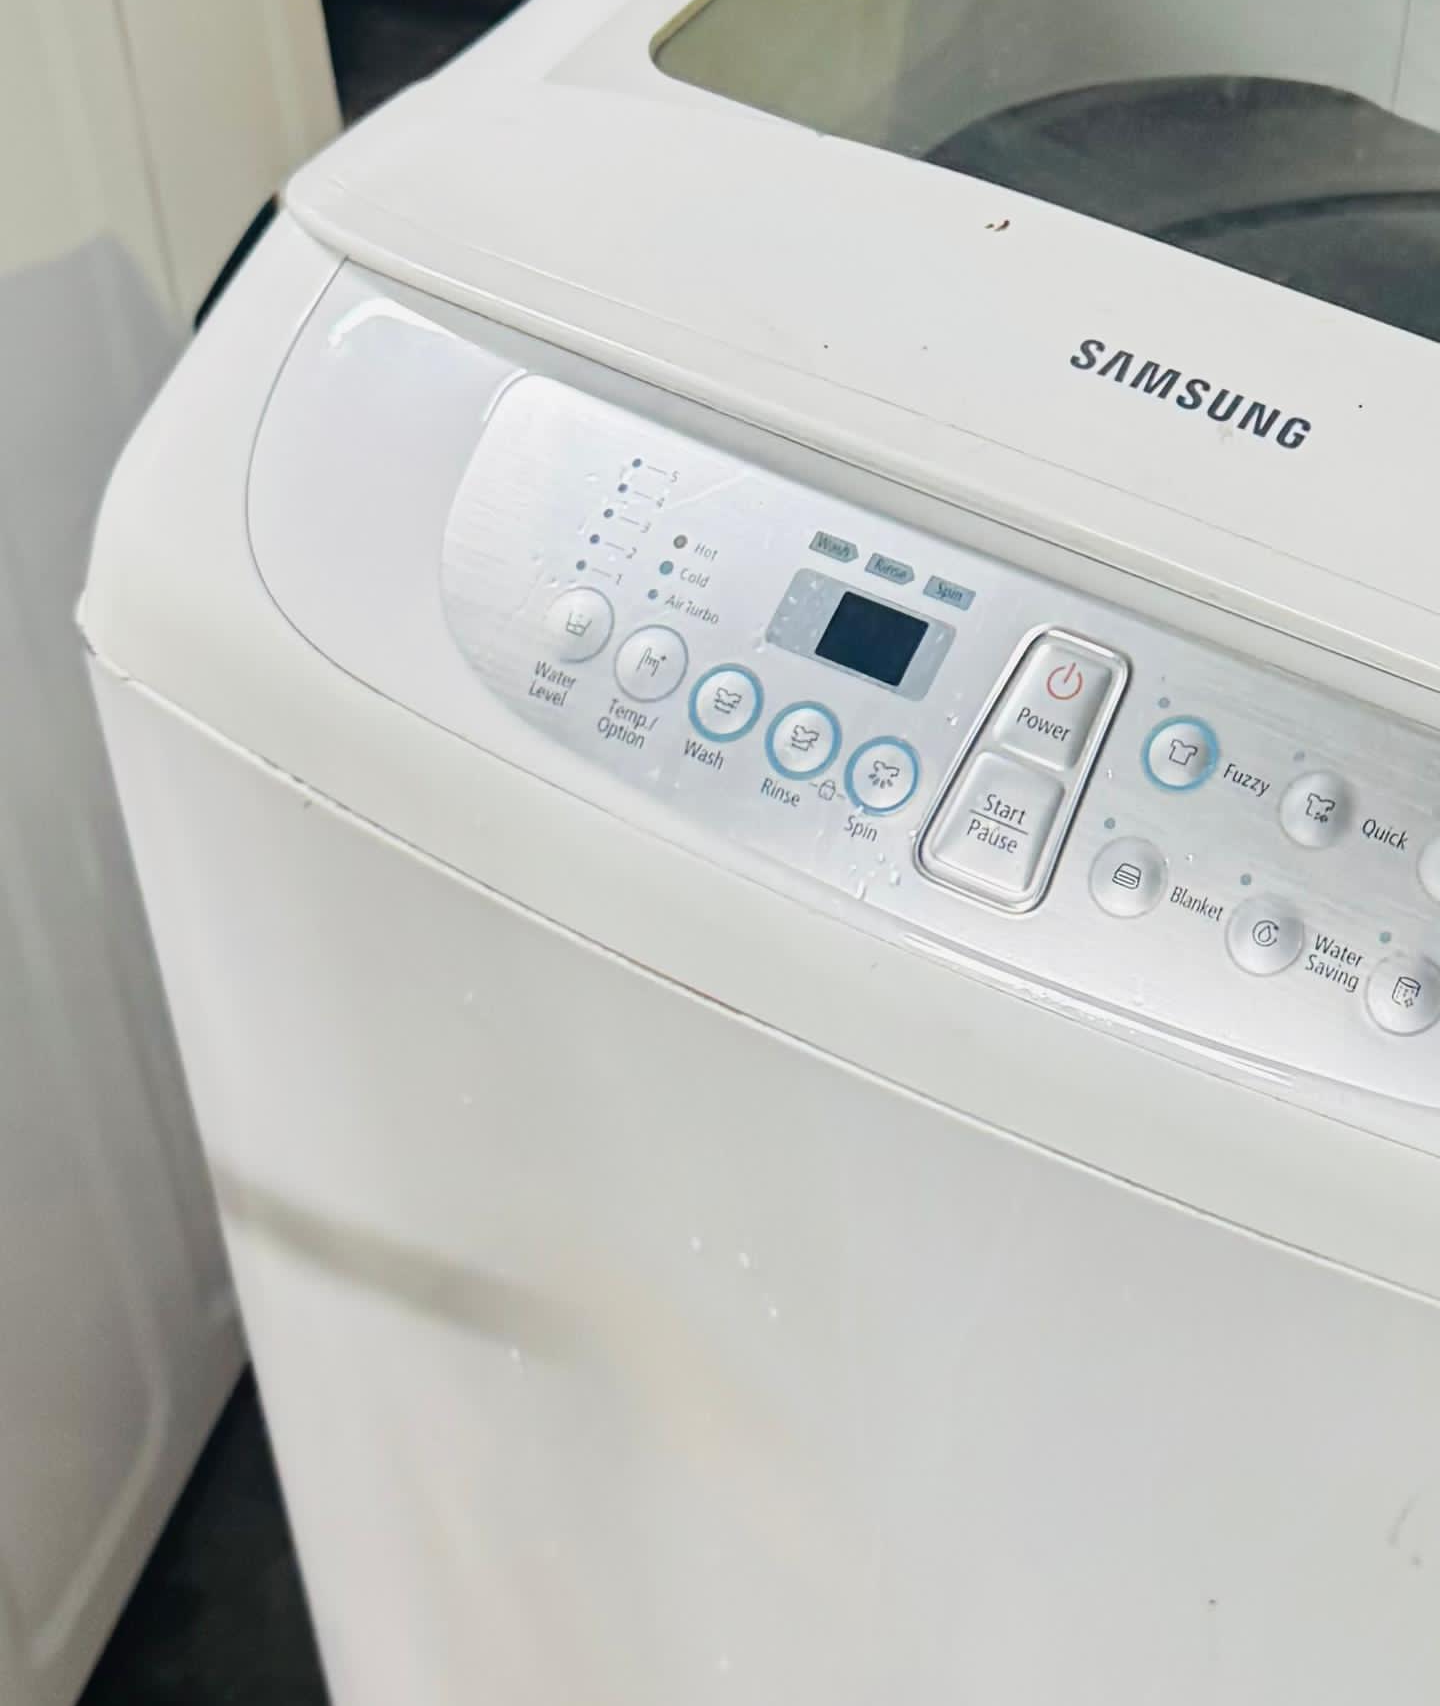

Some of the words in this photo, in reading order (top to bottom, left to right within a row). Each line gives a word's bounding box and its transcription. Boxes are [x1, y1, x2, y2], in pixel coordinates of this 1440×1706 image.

[1069, 339, 1312, 449] SAMSUNG
[671, 470, 680, 483] 5
[626, 547, 637, 559] 2
[694, 543, 718, 561] Hot
[817, 536, 849, 558] Wash
[615, 573, 623, 585] 1
[680, 568, 710, 588] Cold
[874, 558, 907, 578] Rinse
[937, 581, 963, 601] Spin
[664, 594, 685, 609] Air
[686, 600, 720, 625] Turbo
[534, 660, 577, 690] Water
[528, 680, 568, 707] Level
[607, 698, 660, 731] Temp./
[1016, 706, 1071, 742] Power
[596, 717, 646, 750] Option
[683, 739, 725, 771] Wash
[760, 777, 801, 808] Rinse
[1223, 763, 1270, 798] Fuzzy
[983, 793, 1027, 826] Start
[843, 815, 879, 843] Spin
[966, 818, 1018, 854] Pause
[1361, 818, 1409, 850] Quick
[1170, 886, 1224, 923] Blanket
[1314, 933, 1364, 968] Water
[1304, 954, 1360, 994] Saving
